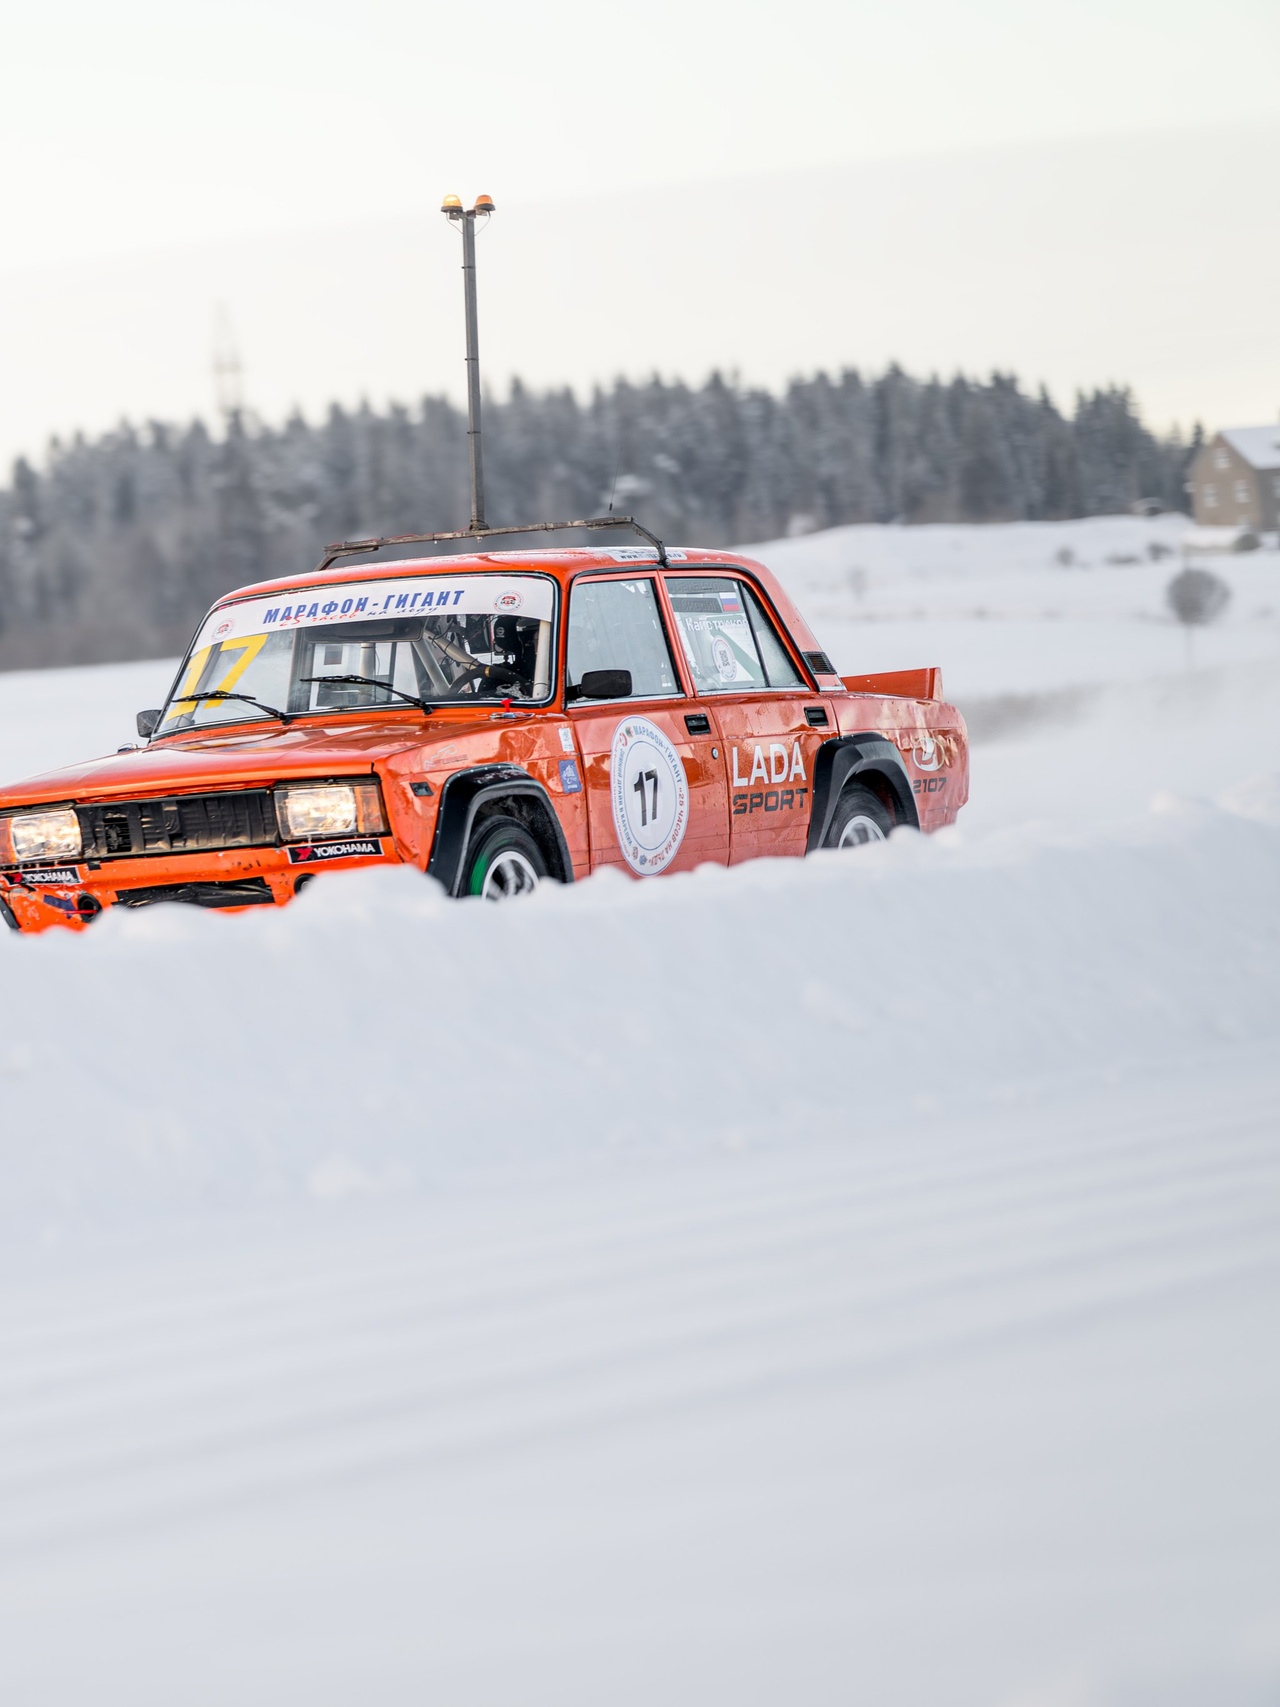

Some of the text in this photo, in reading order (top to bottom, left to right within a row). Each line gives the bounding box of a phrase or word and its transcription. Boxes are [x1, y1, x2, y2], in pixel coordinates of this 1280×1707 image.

[279, 614, 305, 627] 25
[165, 633, 269, 722] 17
[732, 741, 808, 787] LADA
[913, 776, 947, 794] 2107
[633, 768, 658, 827] 17
[733, 787, 808, 815] SPORT
[671, 809, 684, 843] ЧАСОВ
[313, 843, 376, 857] YOKOHAMA
[664, 840, 673, 855] НА
[22, 871, 76, 882] YOKOHAMA
